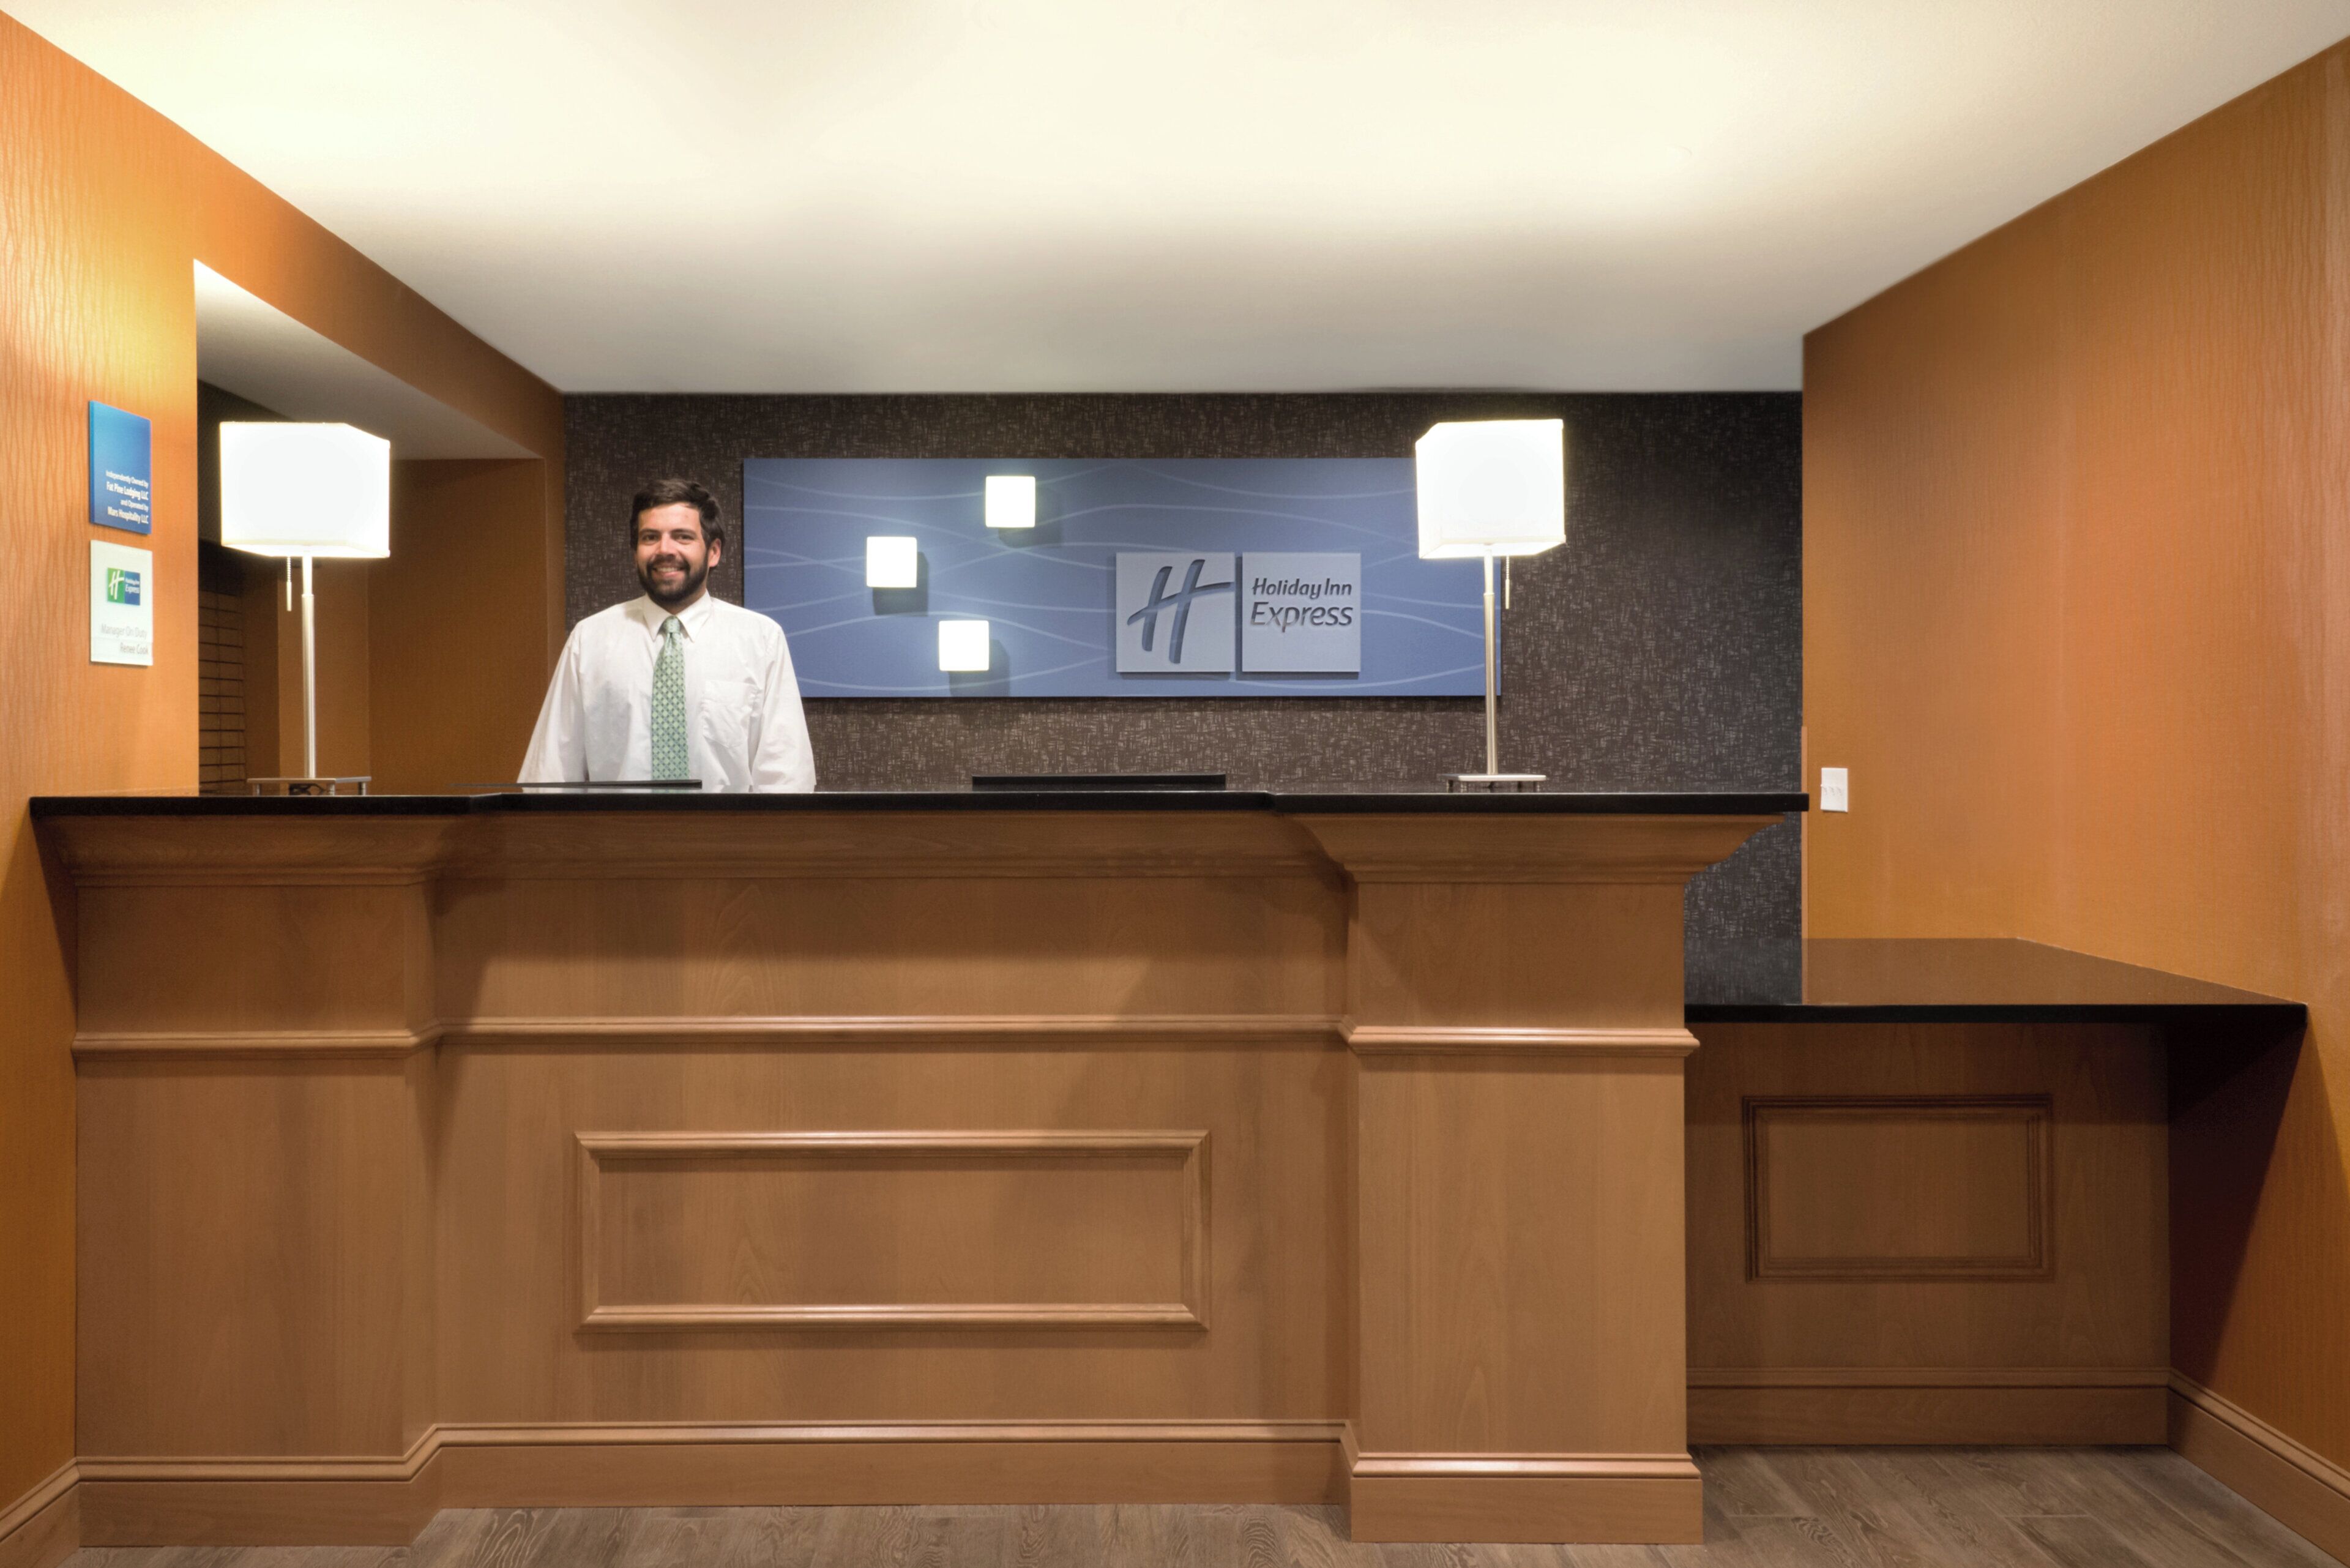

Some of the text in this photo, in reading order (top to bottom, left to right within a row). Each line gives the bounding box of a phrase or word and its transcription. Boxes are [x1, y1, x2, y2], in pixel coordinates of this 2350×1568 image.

[106, 470, 131, 484] Independently
[114, 483, 124, 495] Pine
[124, 486, 141, 501] Lodging
[127, 500, 143, 510] Operated
[143, 504, 148, 512] by
[108, 506, 118, 517] Mars
[118, 509, 141, 524] Hospitality
[125, 584, 140, 594] Express
[1251, 578, 1352, 600] Holiday Inn
[1250, 602, 1354, 633] Express
[102, 623, 148, 640] Manager On Duty
[136, 644, 149, 655] Cook
